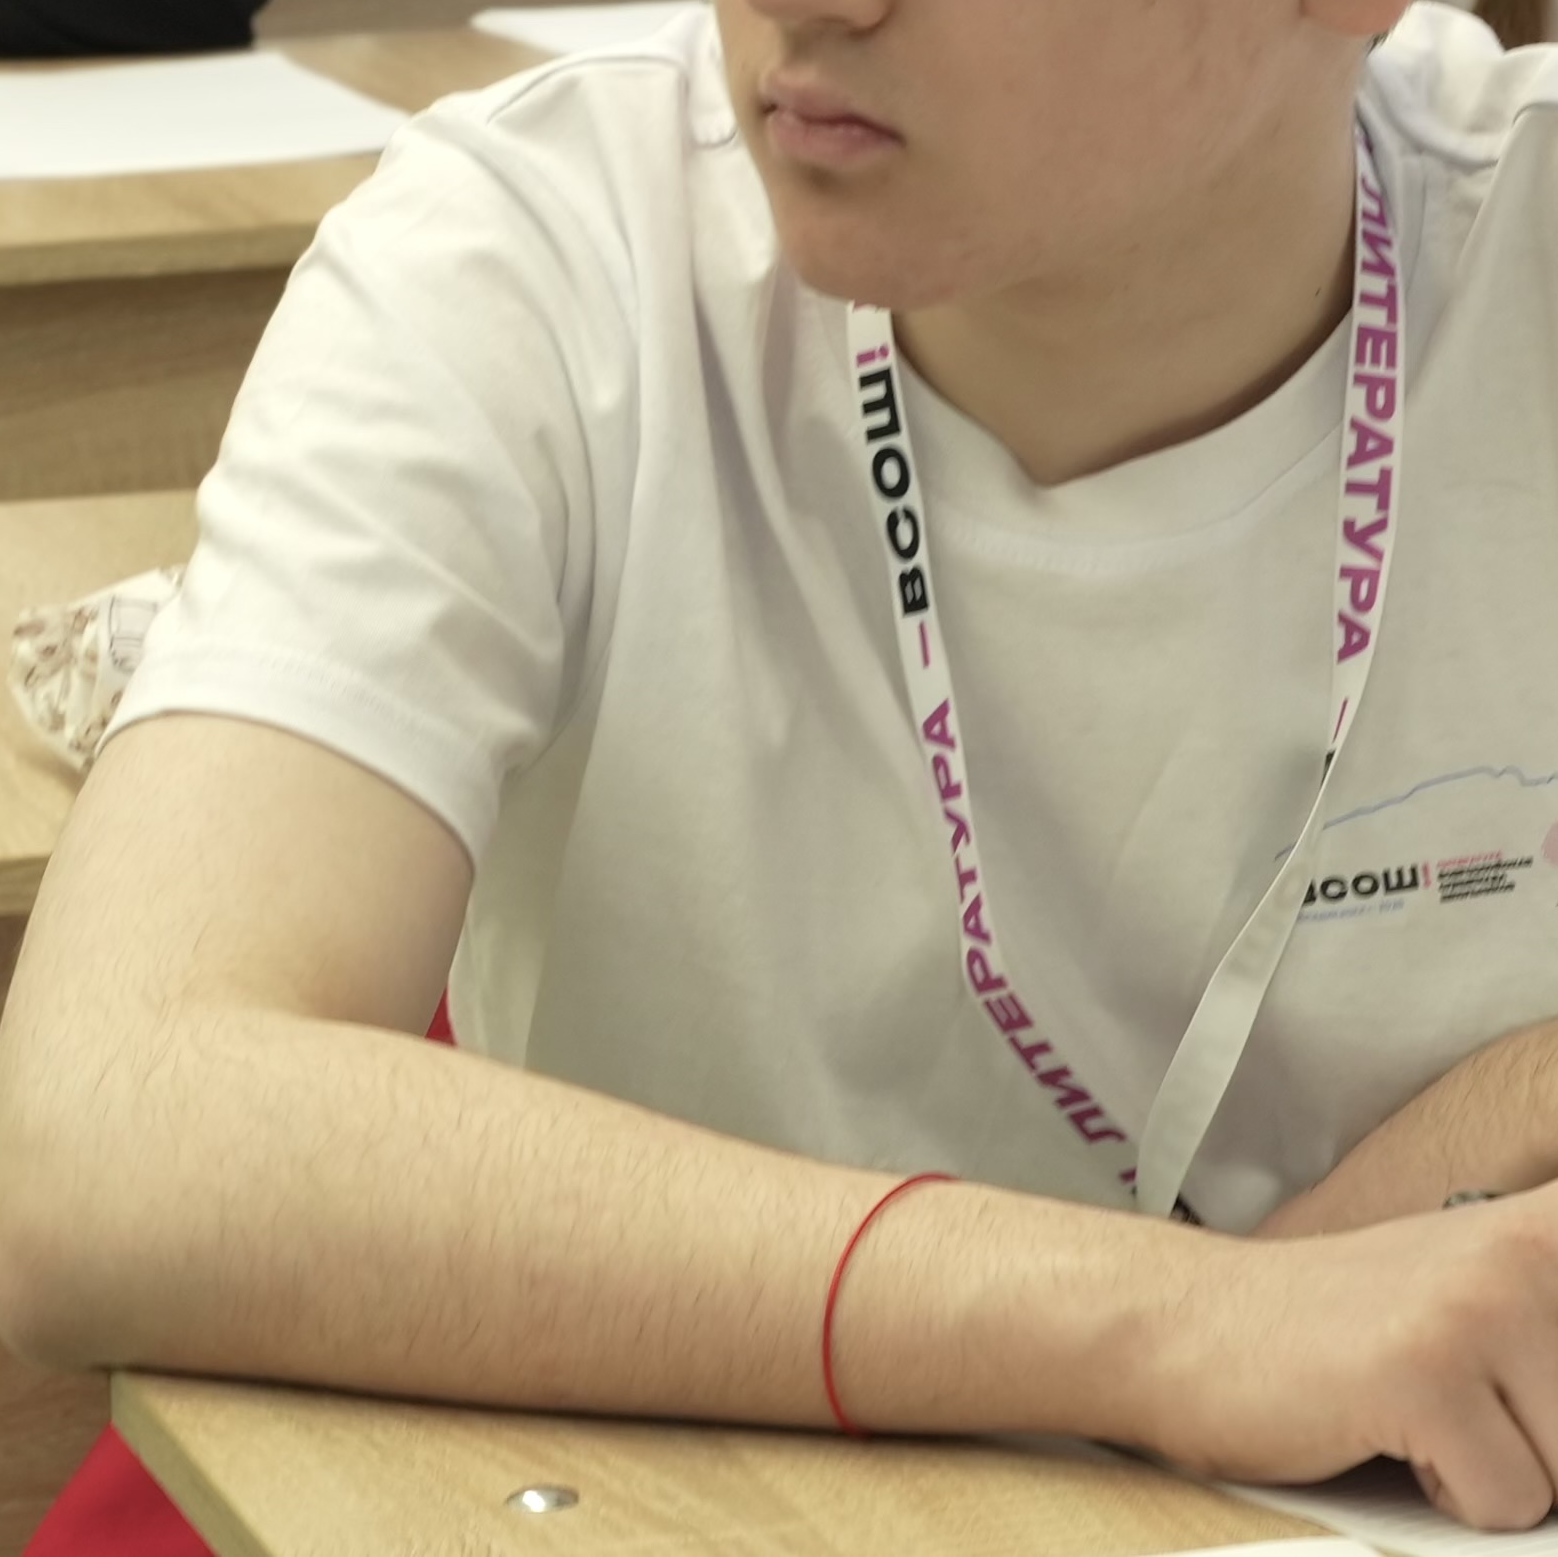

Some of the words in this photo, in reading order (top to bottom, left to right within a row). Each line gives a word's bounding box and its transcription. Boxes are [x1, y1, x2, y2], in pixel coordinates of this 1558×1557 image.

[856, 344, 931, 619] ВСОШ!
[1336, 175, 1398, 666] ЛИТЕРАТУРА
[922, 697, 1128, 1145] ЛИТЕРАТУРА
